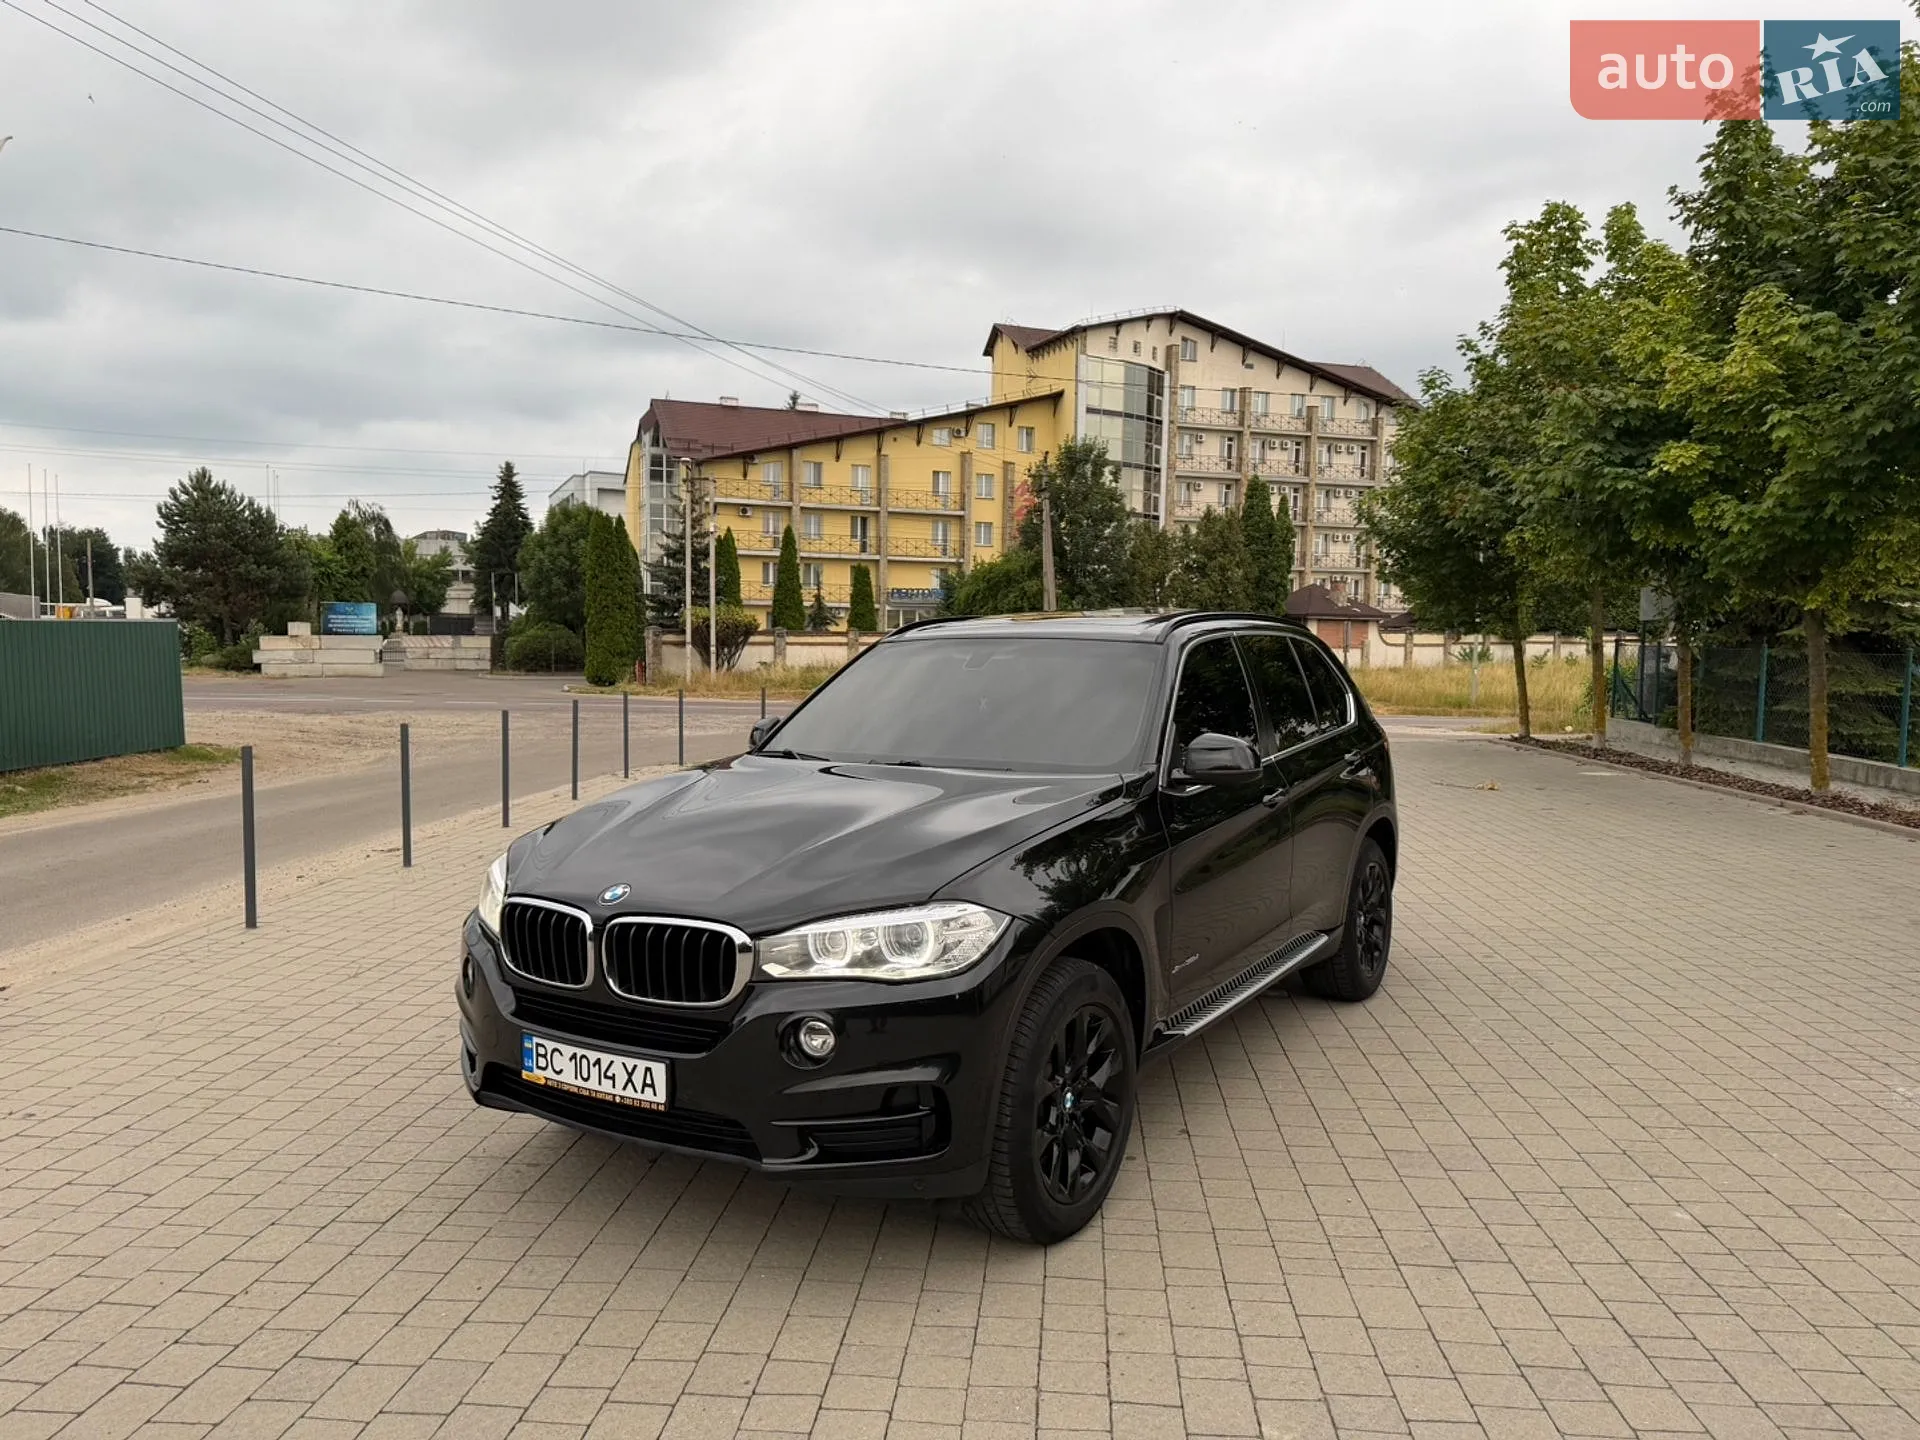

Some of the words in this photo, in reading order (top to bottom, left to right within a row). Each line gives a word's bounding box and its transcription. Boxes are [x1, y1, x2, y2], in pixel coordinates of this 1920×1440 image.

[535, 1042, 563, 1075] BC
[569, 1052, 616, 1089] 1014
[621, 1061, 658, 1097] XA
